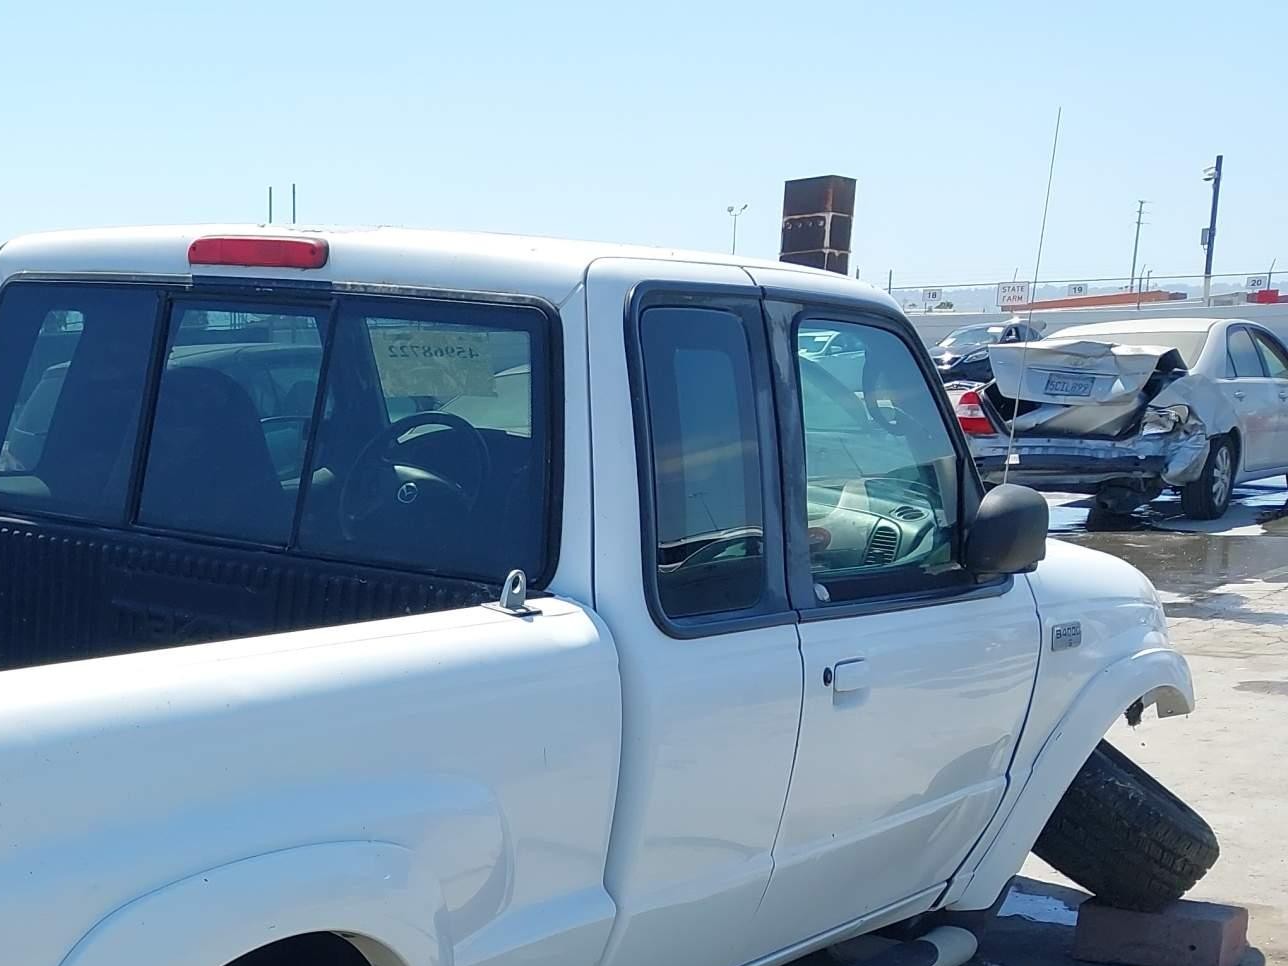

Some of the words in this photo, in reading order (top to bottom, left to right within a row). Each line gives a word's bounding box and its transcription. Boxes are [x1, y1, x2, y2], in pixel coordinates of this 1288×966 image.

[1250, 279, 1262, 287] 20
[1002, 285, 1025, 294] STATE
[1072, 286, 1083, 294] 19
